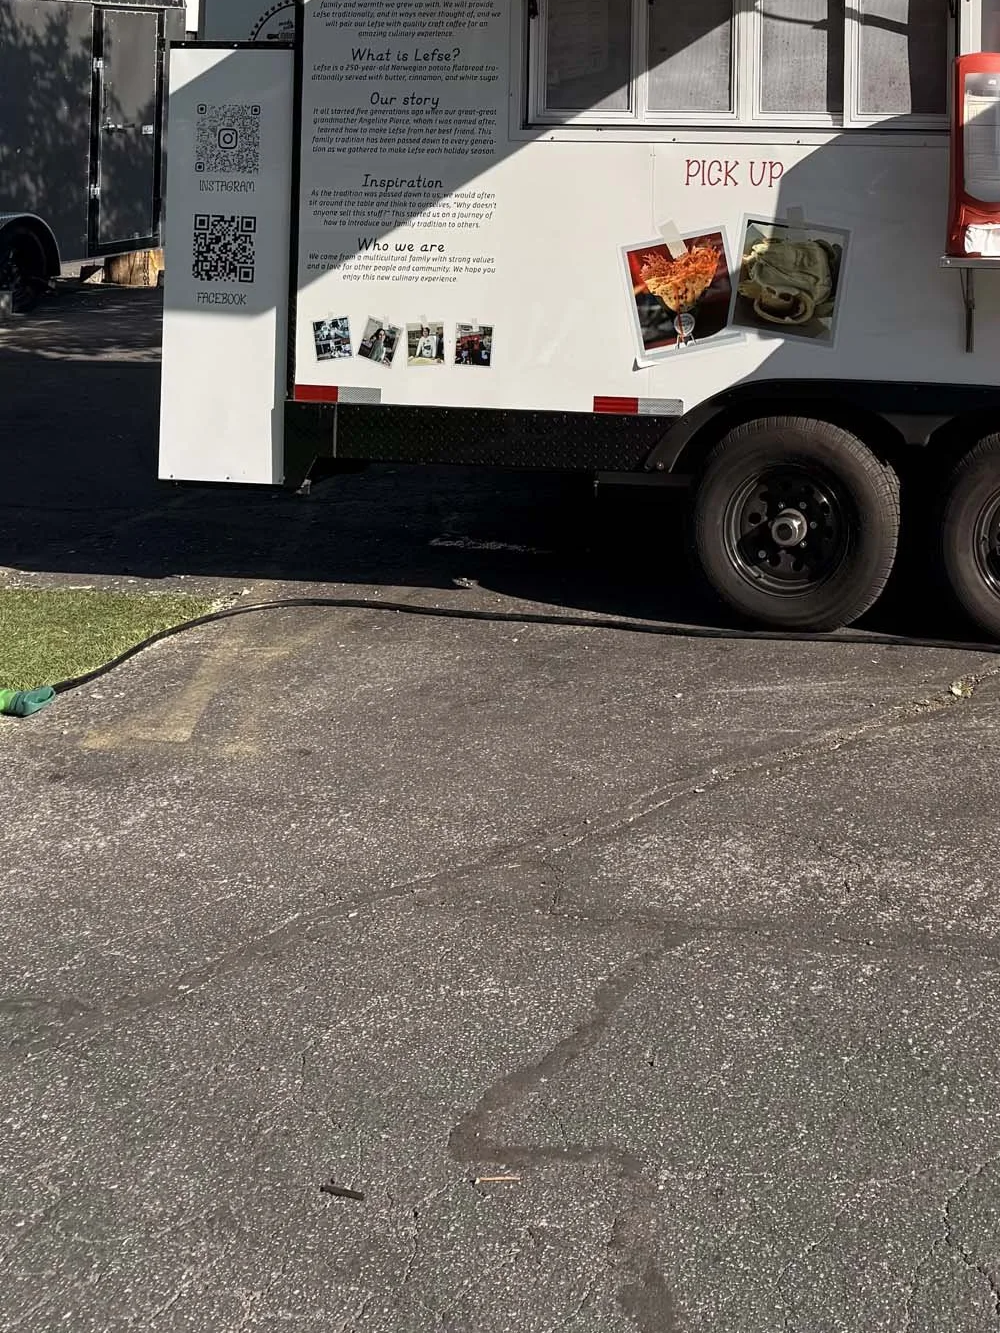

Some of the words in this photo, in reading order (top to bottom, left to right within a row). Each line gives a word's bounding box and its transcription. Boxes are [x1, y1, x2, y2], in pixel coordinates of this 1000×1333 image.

[352, 48, 391, 61] What
[397, 50, 408, 61] is
[414, 48, 461, 62] Lefse?
[370, 92, 396, 106] Our
[403, 92, 440, 109] story
[685, 160, 739, 186] PICK
[750, 161, 784, 187] UP
[199, 180, 255, 192] INSTAGRAM
[362, 174, 443, 192] Inspiration
[357, 238, 389, 251] Who
[395, 243, 414, 252] we
[420, 243, 445, 252] are
[197, 292, 247, 305] FACEBOOK
